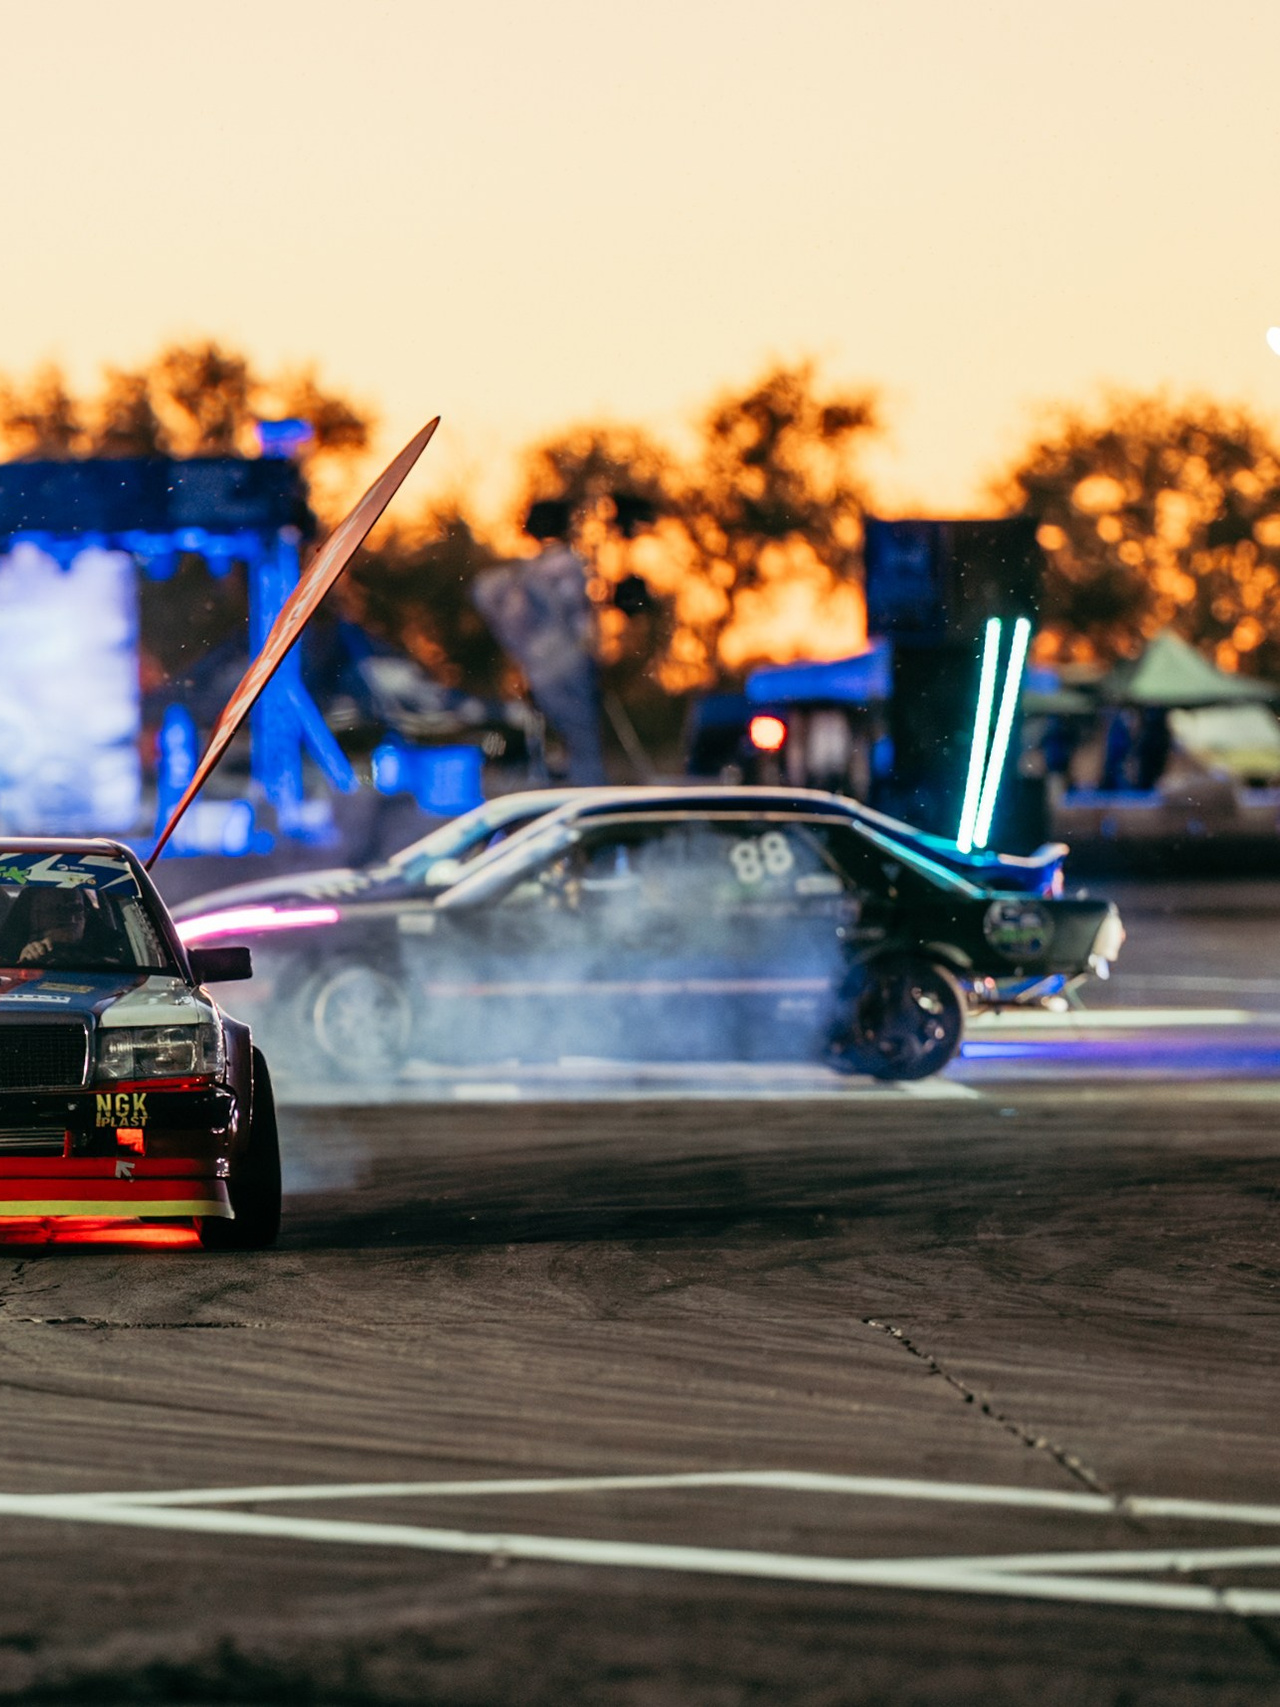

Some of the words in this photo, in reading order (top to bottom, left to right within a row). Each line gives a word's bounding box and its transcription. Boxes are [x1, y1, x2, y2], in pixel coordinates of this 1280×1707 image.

[729, 831, 795, 884] 88
[96, 1093, 147, 1127] NGK
[102, 1116, 148, 1127] PLAST
